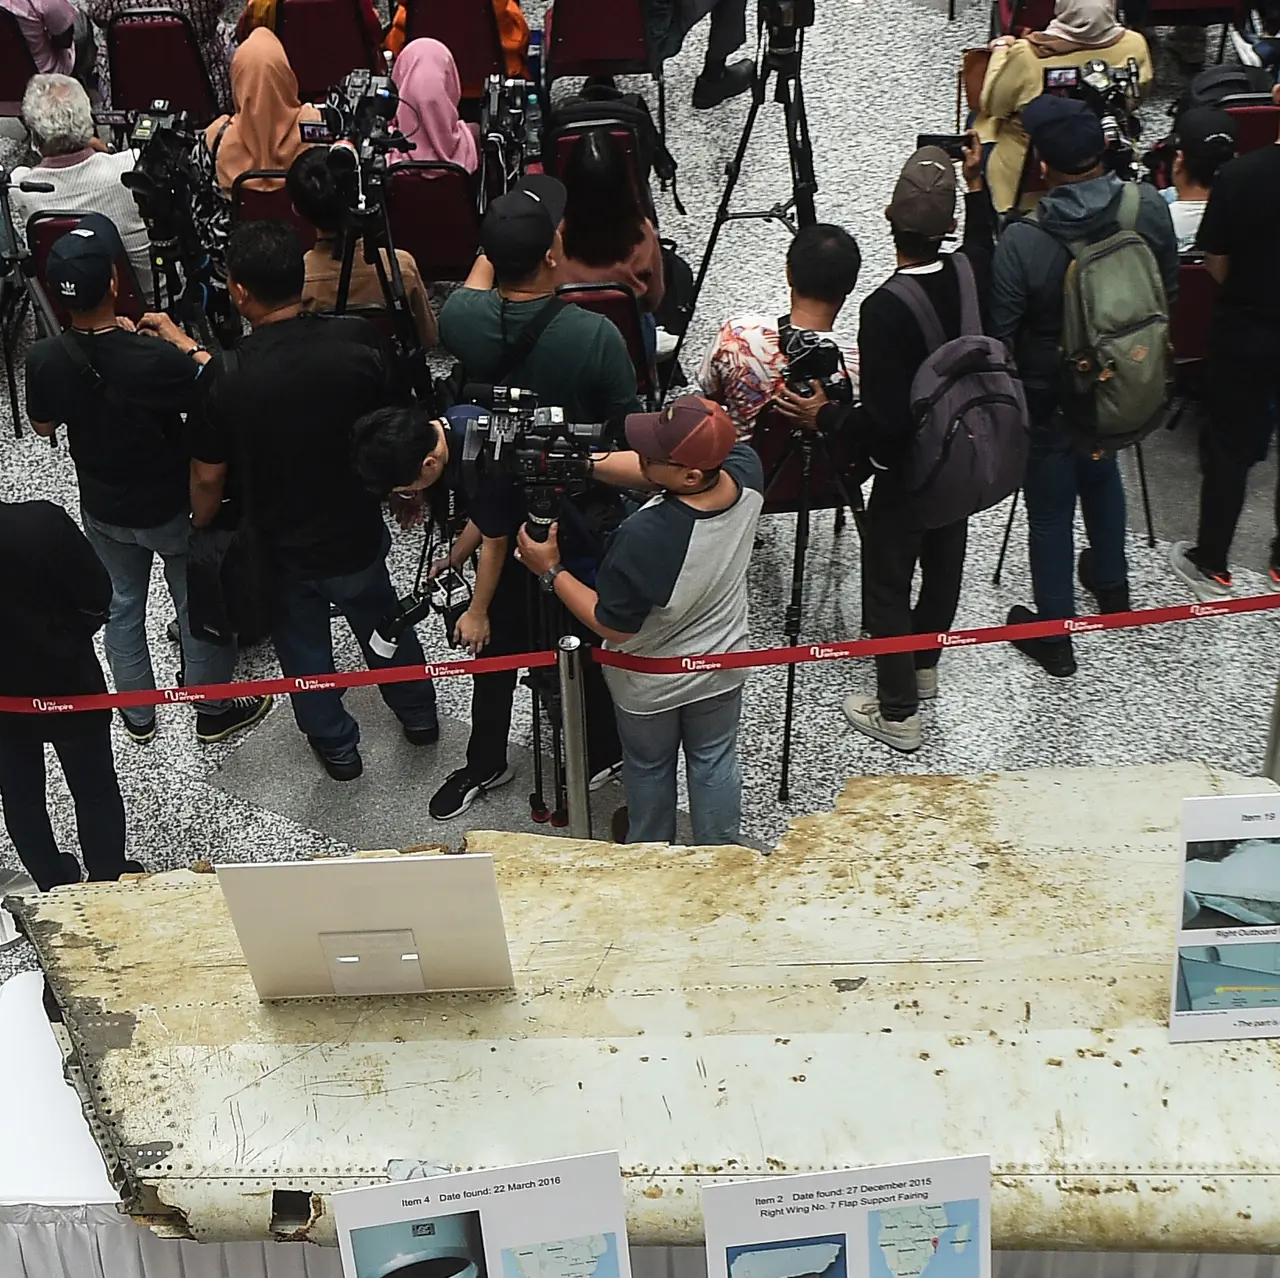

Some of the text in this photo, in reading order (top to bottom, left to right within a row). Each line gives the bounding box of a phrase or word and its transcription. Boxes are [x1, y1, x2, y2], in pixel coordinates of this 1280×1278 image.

[47, 704, 73, 712] empire
[1241, 814, 1262, 822] Item
[401, 1176, 561, 1207] Item 4 Date found: 22 March 2016
[754, 1177, 932, 1206] Item 2 Date found: 27 December 2015
[760, 1192, 929, 1218] Right Wing No. 7 Flap Support Fairing
